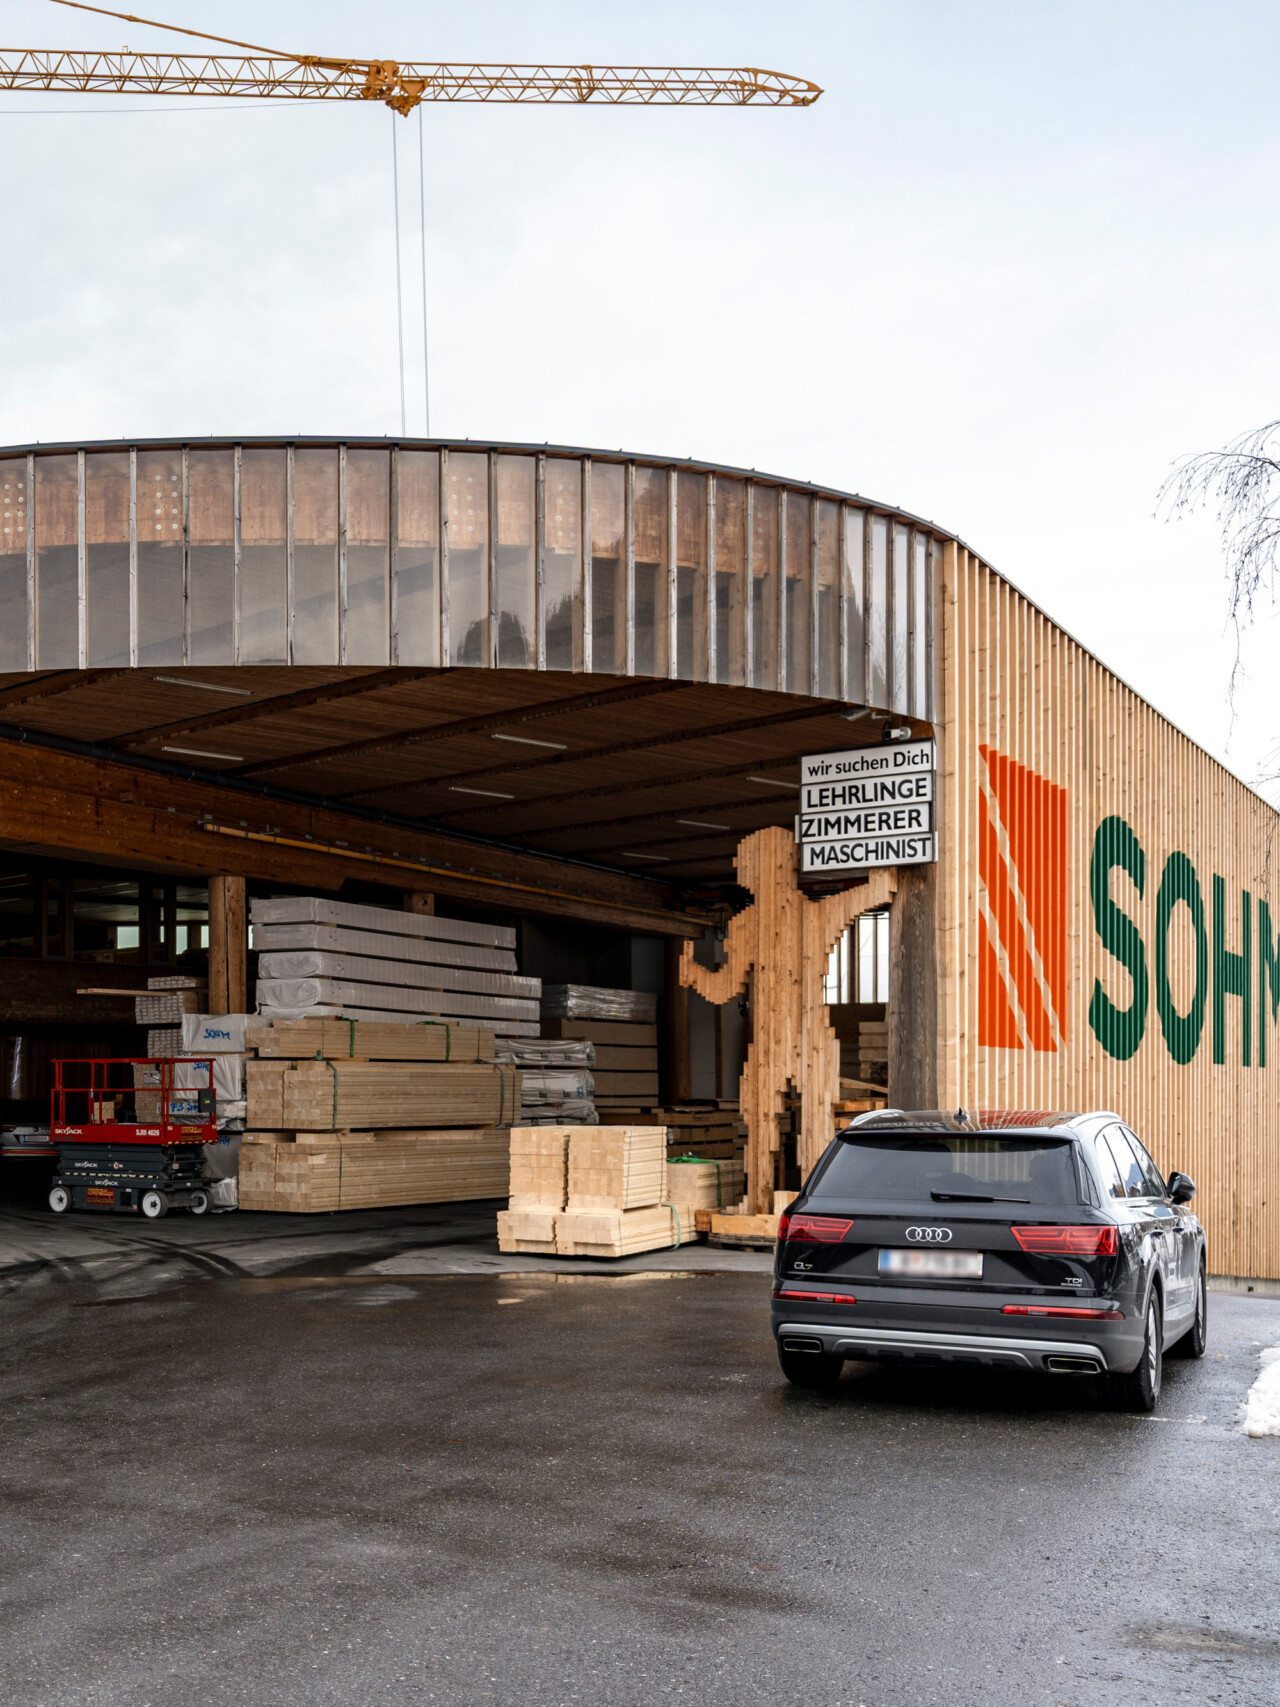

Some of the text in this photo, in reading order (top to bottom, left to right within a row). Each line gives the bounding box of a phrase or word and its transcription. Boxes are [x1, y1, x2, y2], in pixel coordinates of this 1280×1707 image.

[807, 749, 929, 777] wir suchen Dich
[807, 777, 927, 808] LEHRLINGE
[802, 808, 923, 838] ZIMMERER
[810, 837, 932, 866] MASCHINIST
[203, 1028, 231, 1041] SOHM
